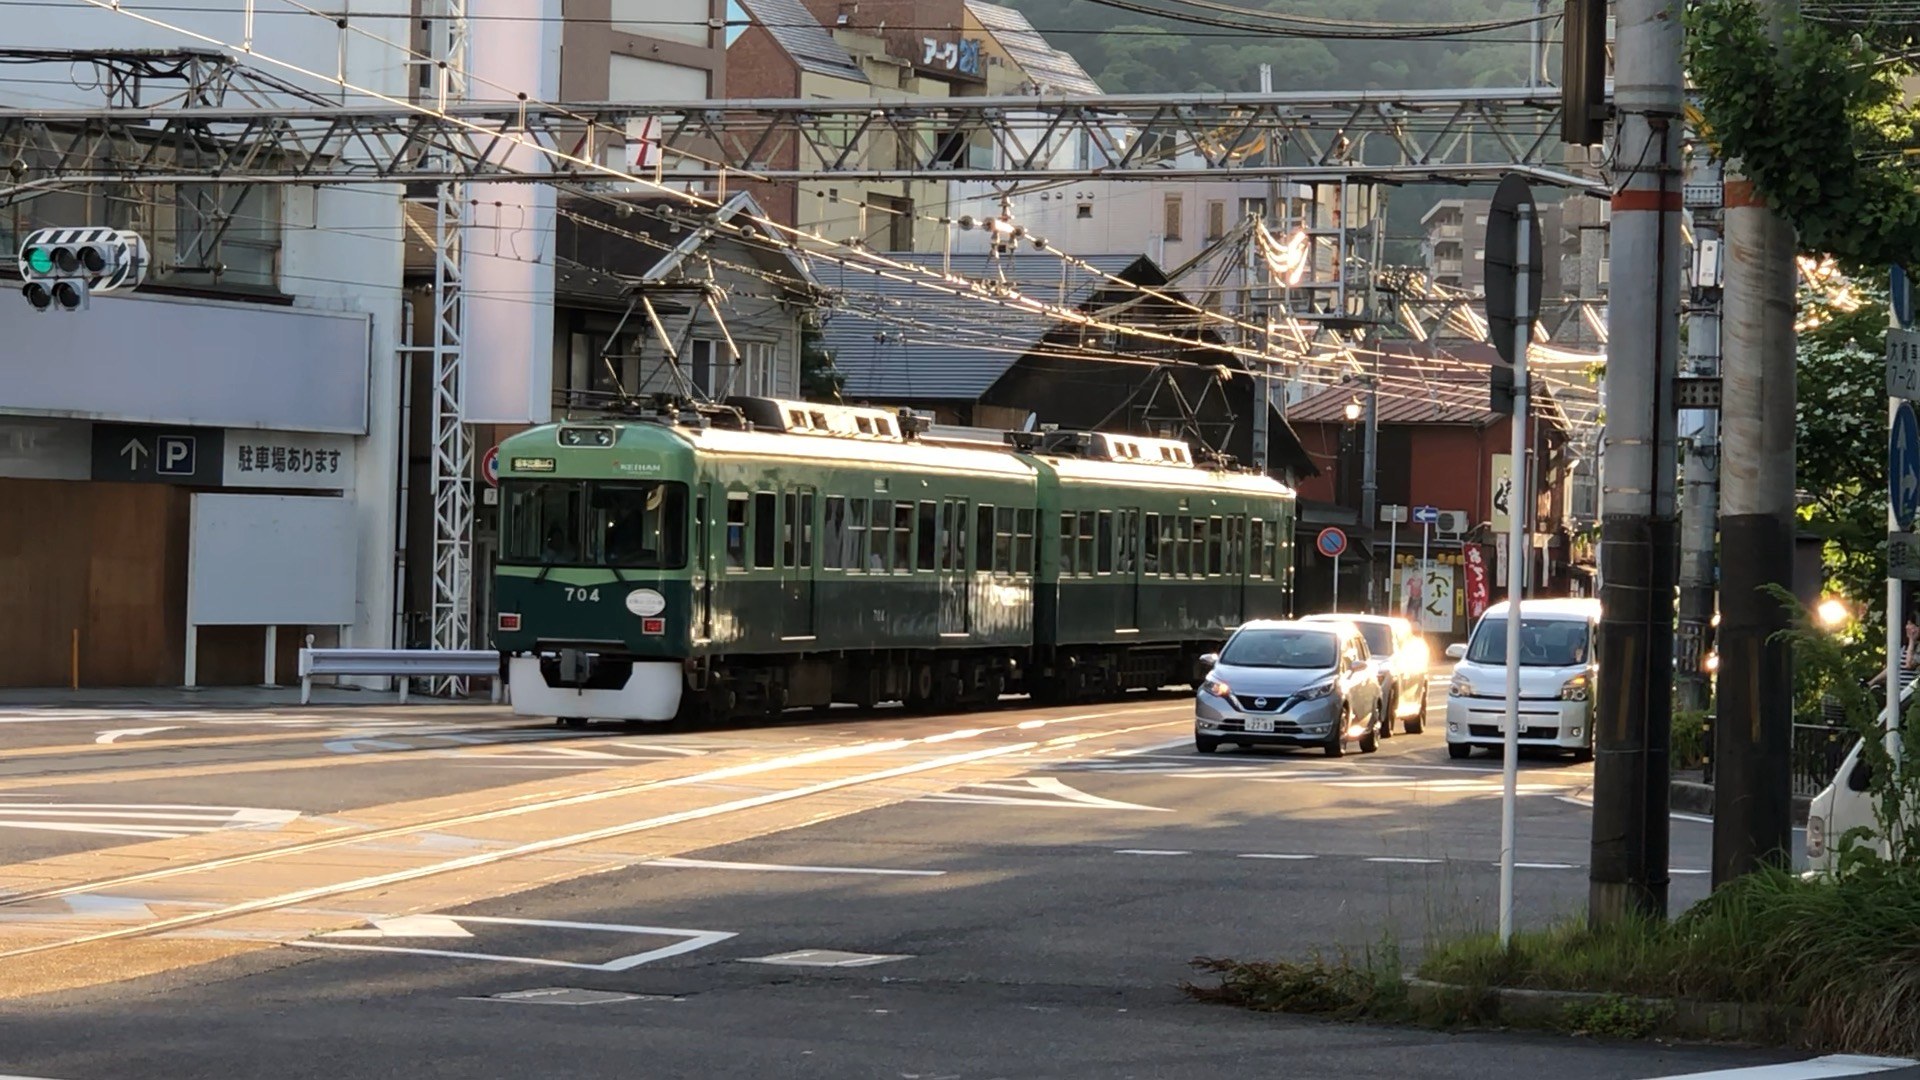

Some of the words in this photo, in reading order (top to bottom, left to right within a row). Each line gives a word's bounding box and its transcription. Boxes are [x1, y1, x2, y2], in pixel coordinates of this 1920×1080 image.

[166, 441, 189, 469] P
[238, 445, 341, 474] 駐車場あります
[565, 587, 600, 602] 704
